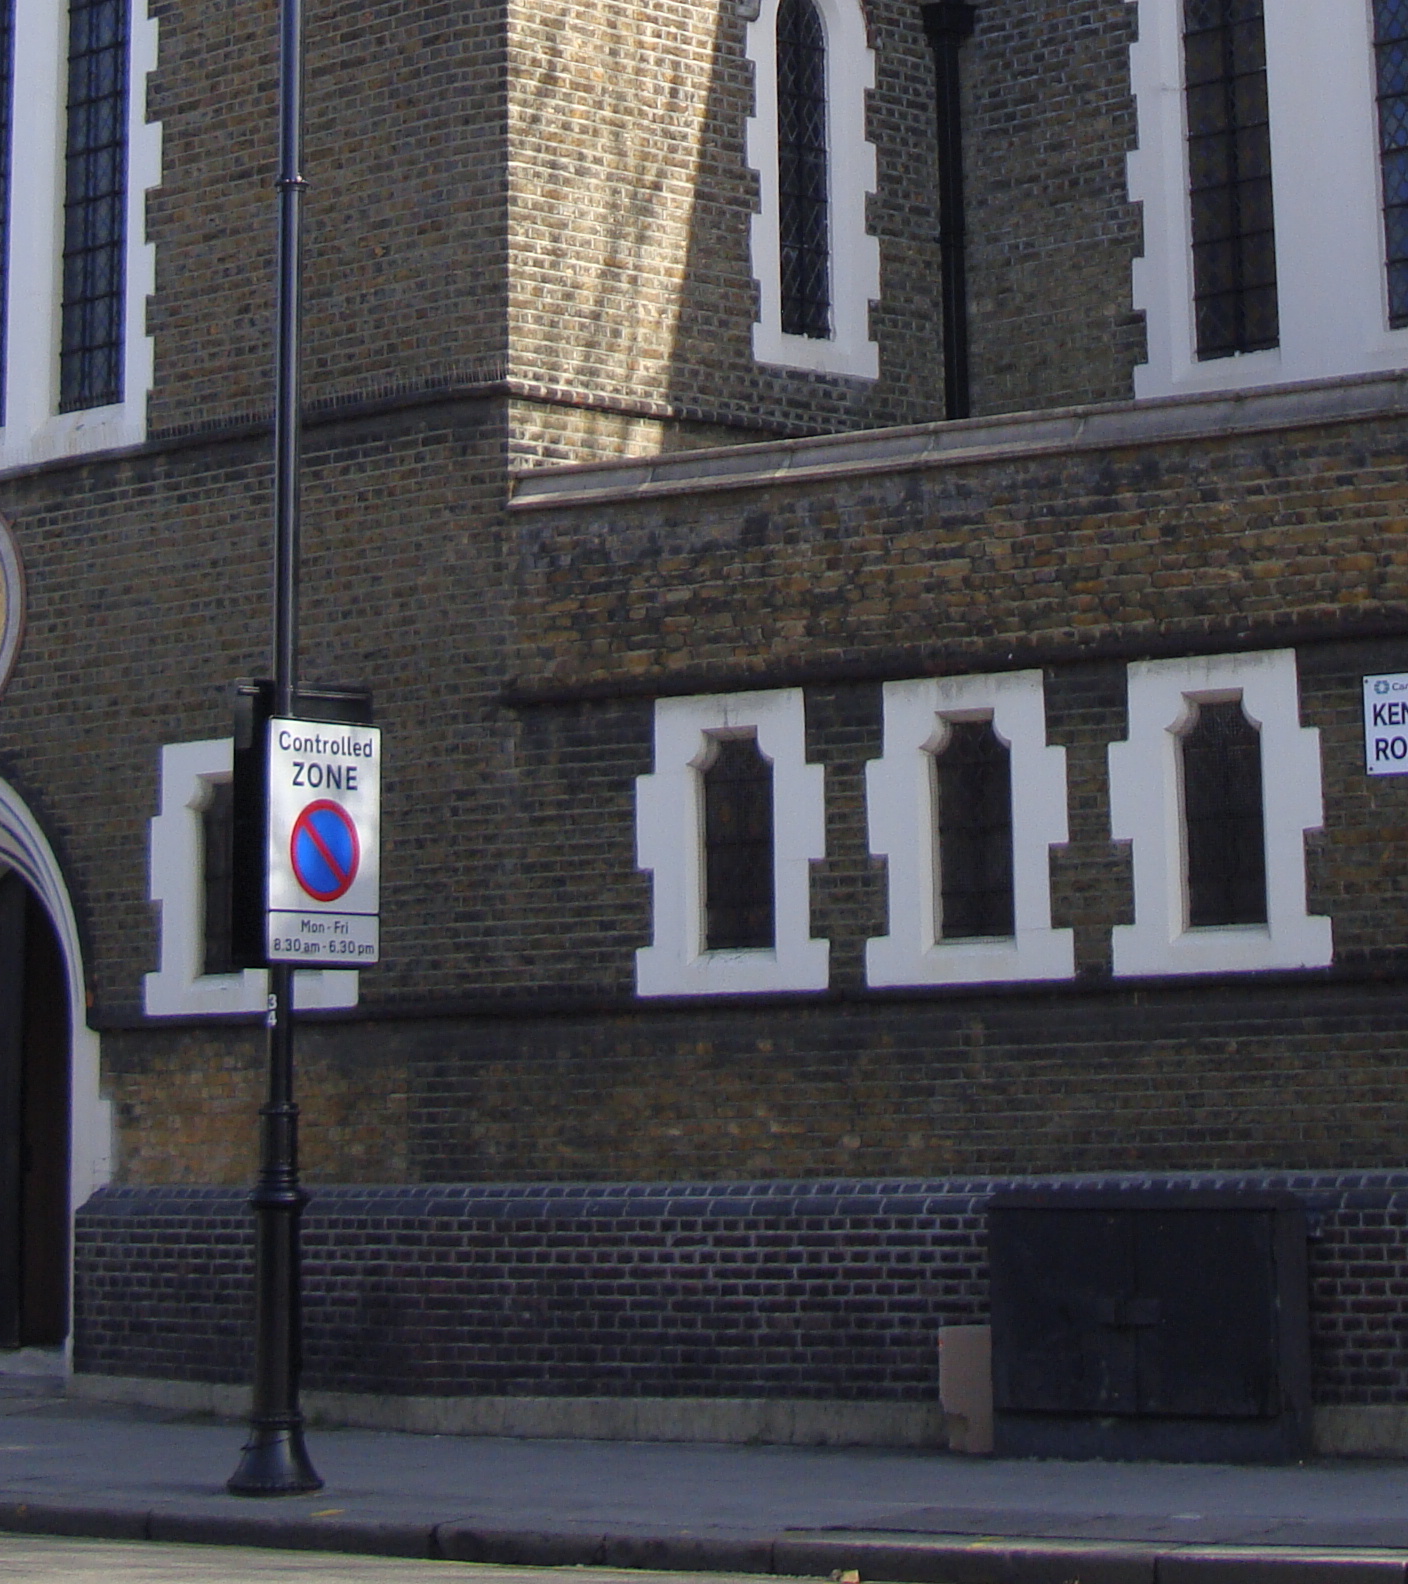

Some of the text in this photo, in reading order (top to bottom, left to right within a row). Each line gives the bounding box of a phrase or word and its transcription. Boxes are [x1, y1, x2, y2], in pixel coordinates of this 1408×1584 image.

[279, 731, 373, 757] Controlled
[292, 762, 358, 790] ZONE
[301, 920, 325, 933] Mon
[334, 921, 349, 934] Fri
[273, 939, 301, 951] 8.30
[304, 943, 320, 952] am
[329, 940, 355, 953] 6.30
[358, 945, 374, 955] pm
